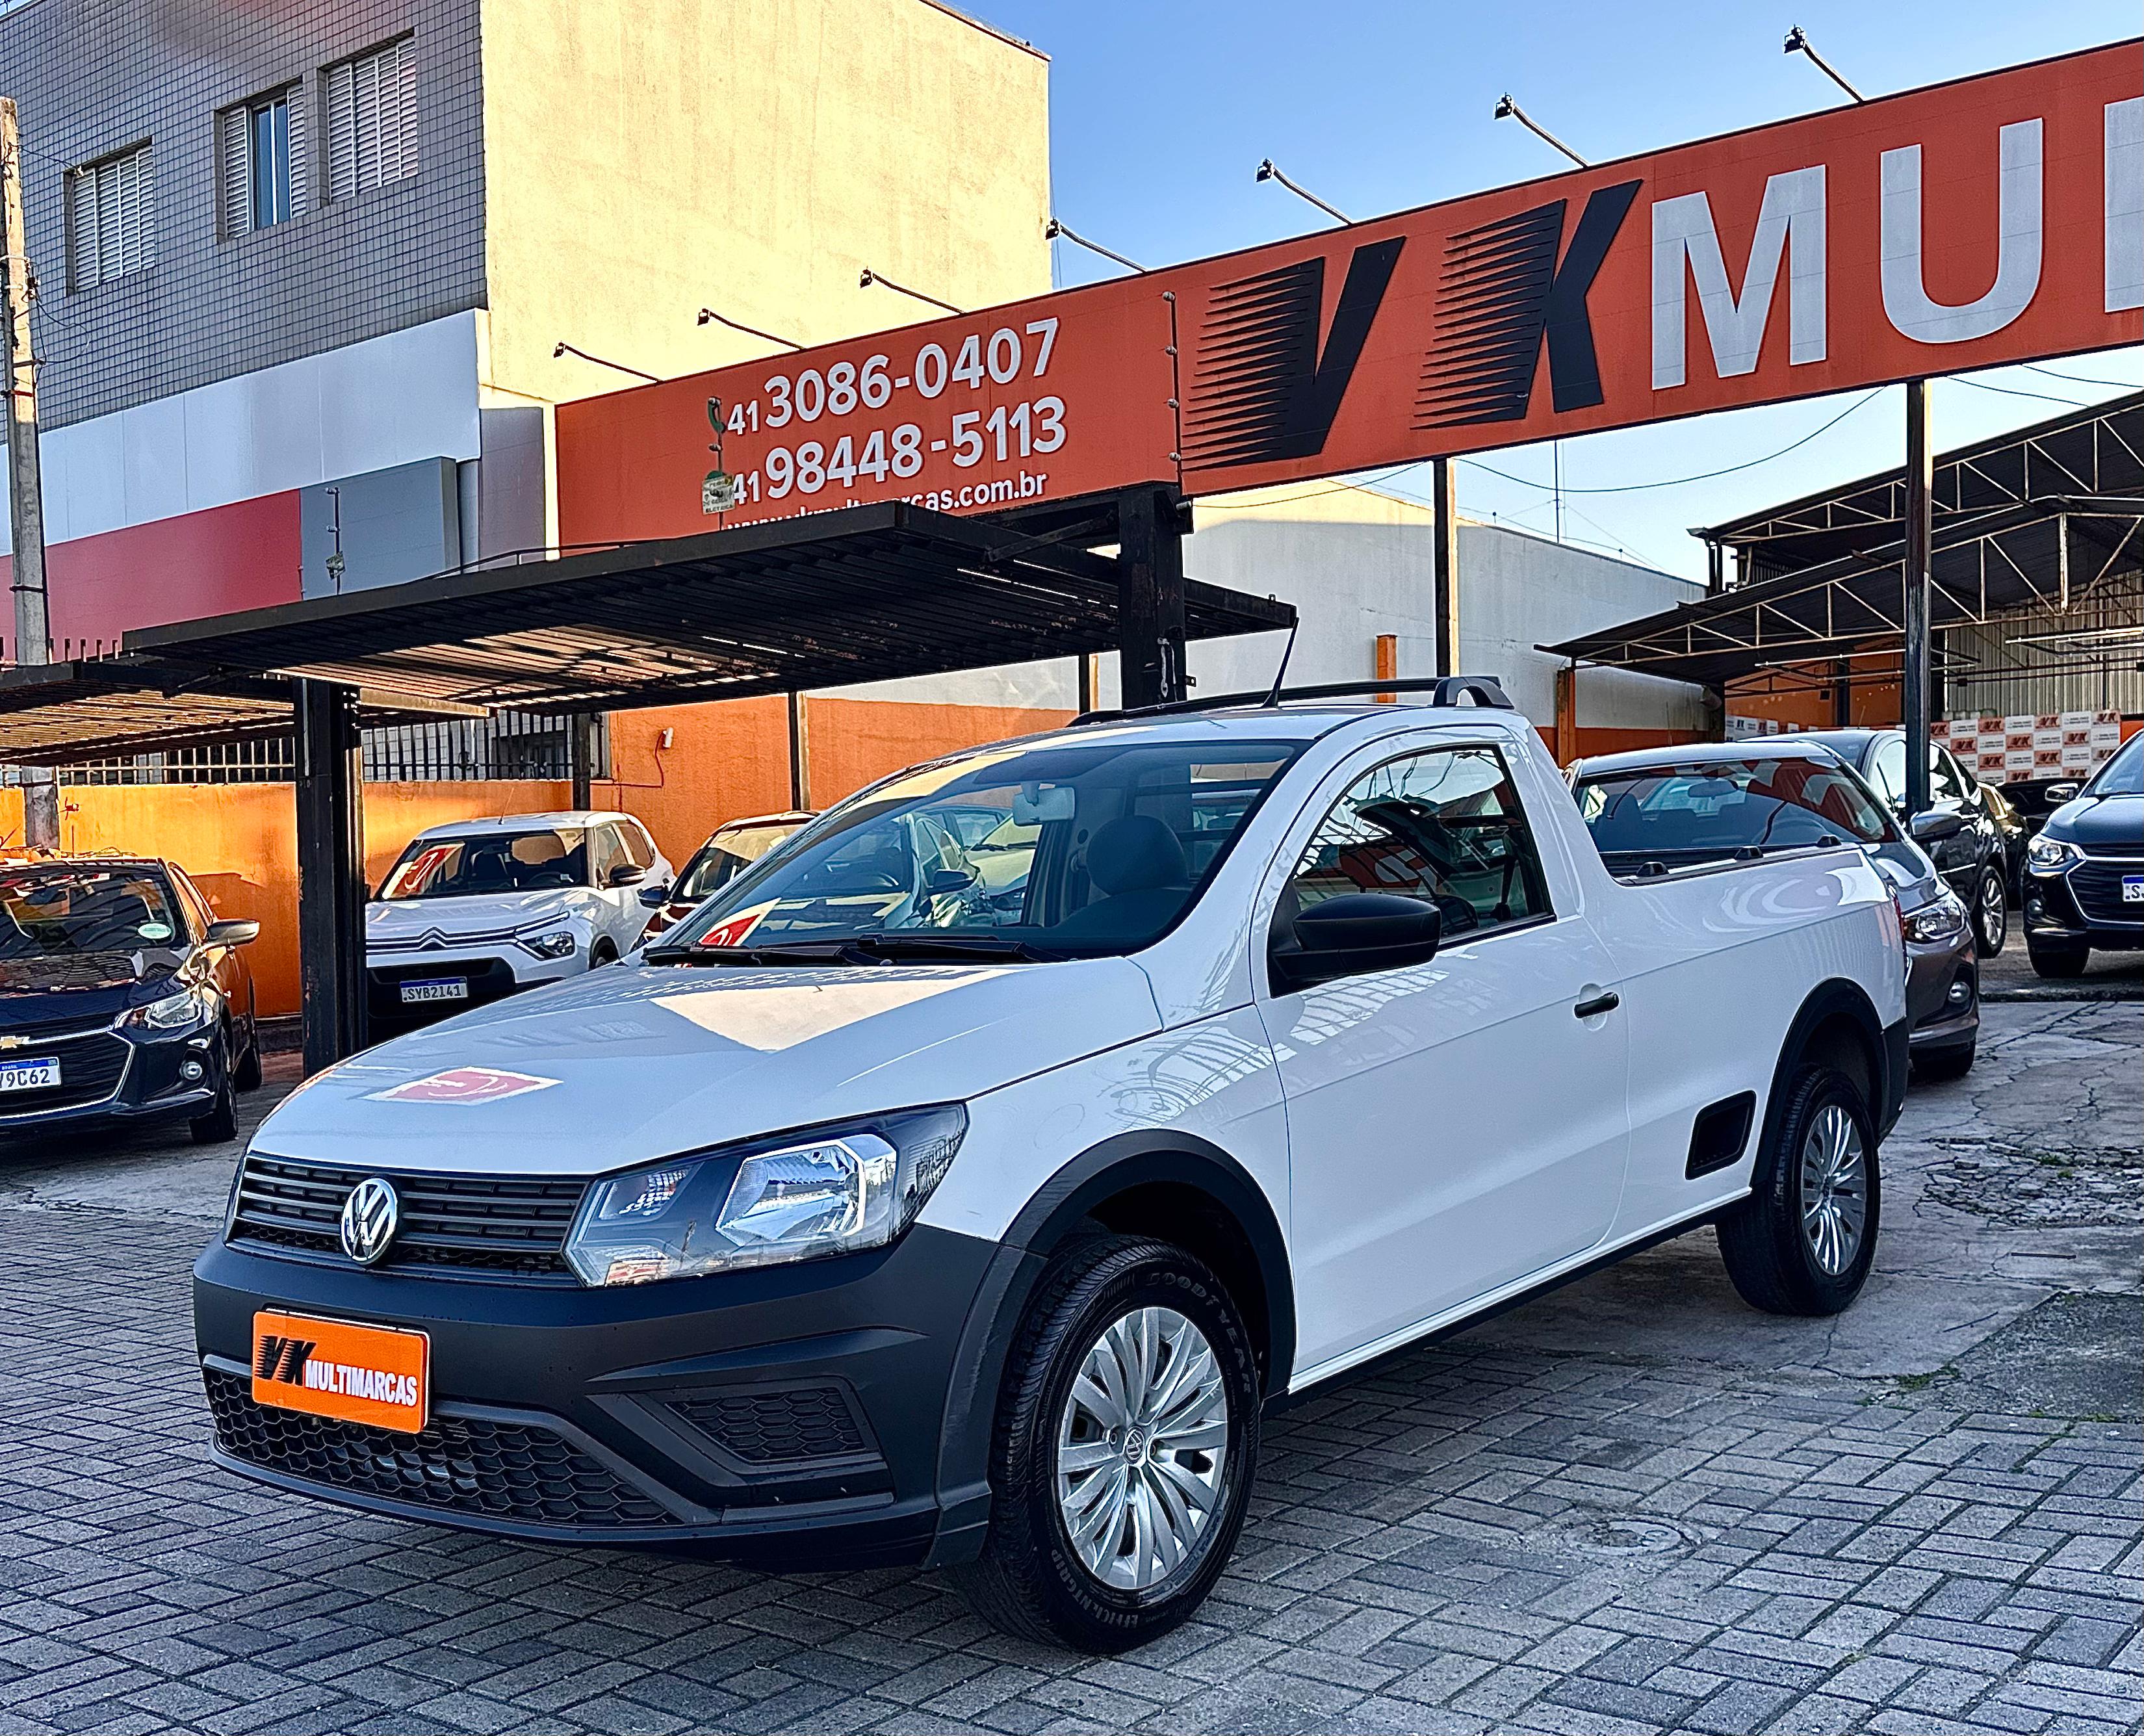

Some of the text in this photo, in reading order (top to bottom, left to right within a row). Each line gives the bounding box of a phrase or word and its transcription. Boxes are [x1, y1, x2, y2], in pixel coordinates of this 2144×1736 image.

[727, 317, 1058, 435] 41 3086-0407
[1182, 179, 1643, 471] VK
[732, 471, 760, 504] 41
[765, 396, 1066, 499] 98448-5113
[407, 985, 461, 1000] SYB2141
[255, 1335, 418, 1406] VK MULTIMARCAS
